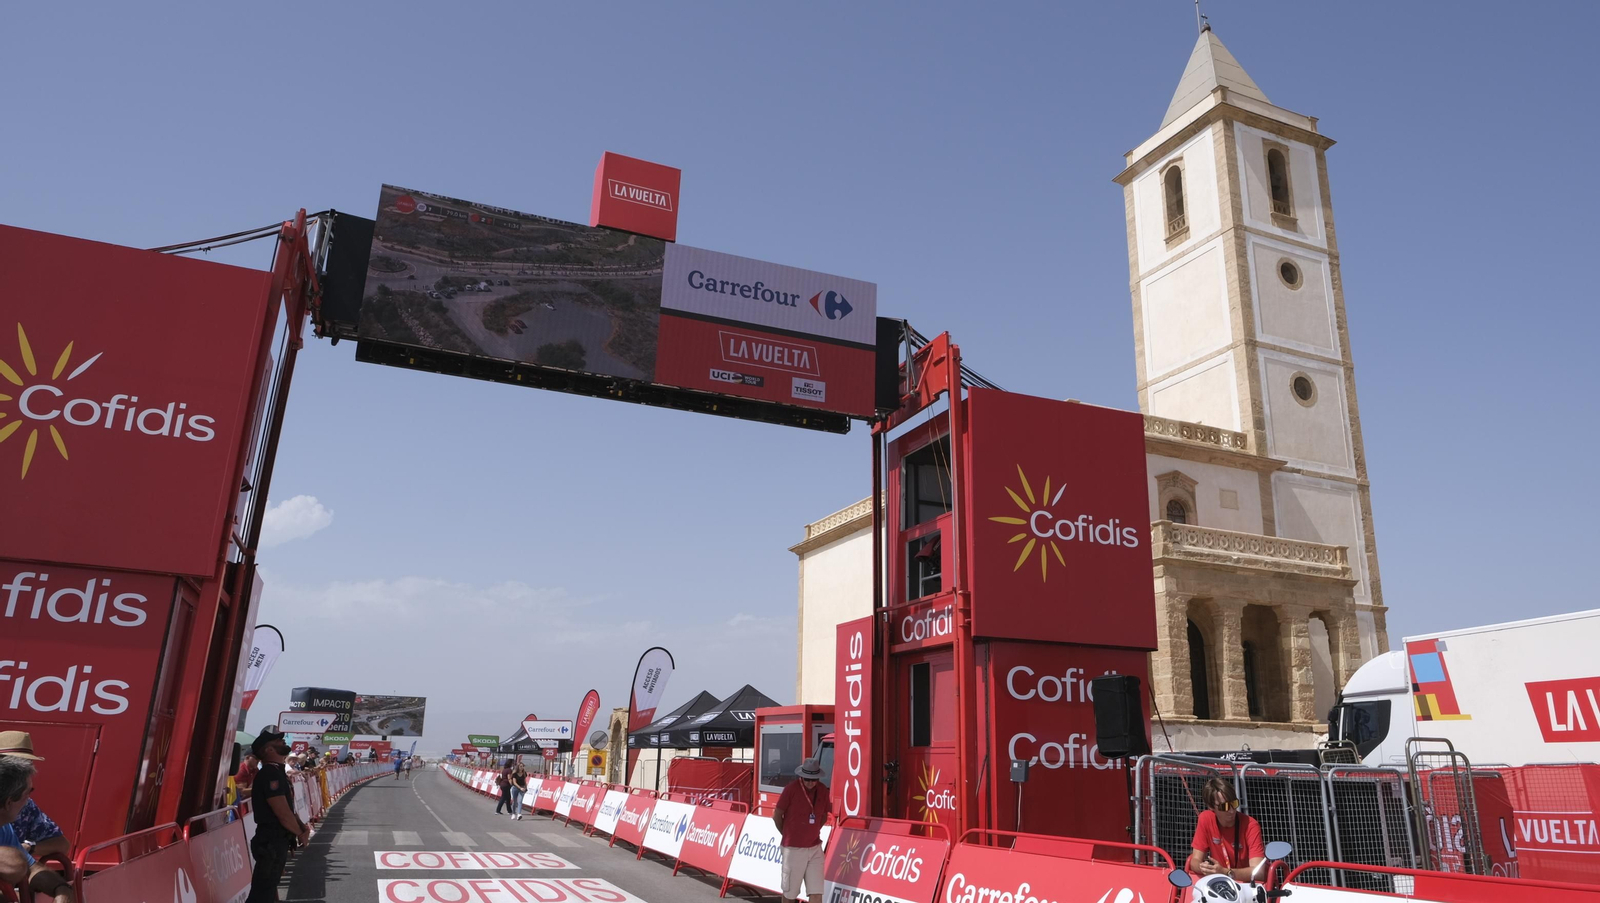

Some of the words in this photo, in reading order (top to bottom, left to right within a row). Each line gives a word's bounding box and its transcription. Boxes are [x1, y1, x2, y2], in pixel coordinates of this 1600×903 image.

[615, 184, 627, 197] LA
[629, 187, 667, 207] VUELTA
[687, 270, 800, 307] Carrefour
[729, 338, 749, 359] LA
[752, 342, 810, 369] VUELTA
[712, 370, 731, 381] UCI
[794, 386, 823, 396] TISSOT
[18, 384, 216, 442] Cofidis
[1030, 510, 1139, 548] Cofidis
[1, 571, 148, 627] fidis
[901, 604, 952, 643] Cofidi
[254, 653, 266, 668] META
[643, 668, 654, 690] ACCESO
[647, 667, 662, 694] INVITADOS
[1006, 665, 1117, 702] Cofi
[282, 718, 314, 726] Carrefour
[843, 631, 863, 816] Cofidis
[1545, 690, 1588, 731] LA
[295, 743, 305, 751] 25
[686, 821, 718, 847] Carrefour
[1518, 818, 1600, 845] VUELTA
[379, 851, 566, 869] COFIDIS
[738, 833, 783, 864] Carrefou
[859, 843, 923, 883] Cofidis
[385, 879, 628, 903] COFIDIS
